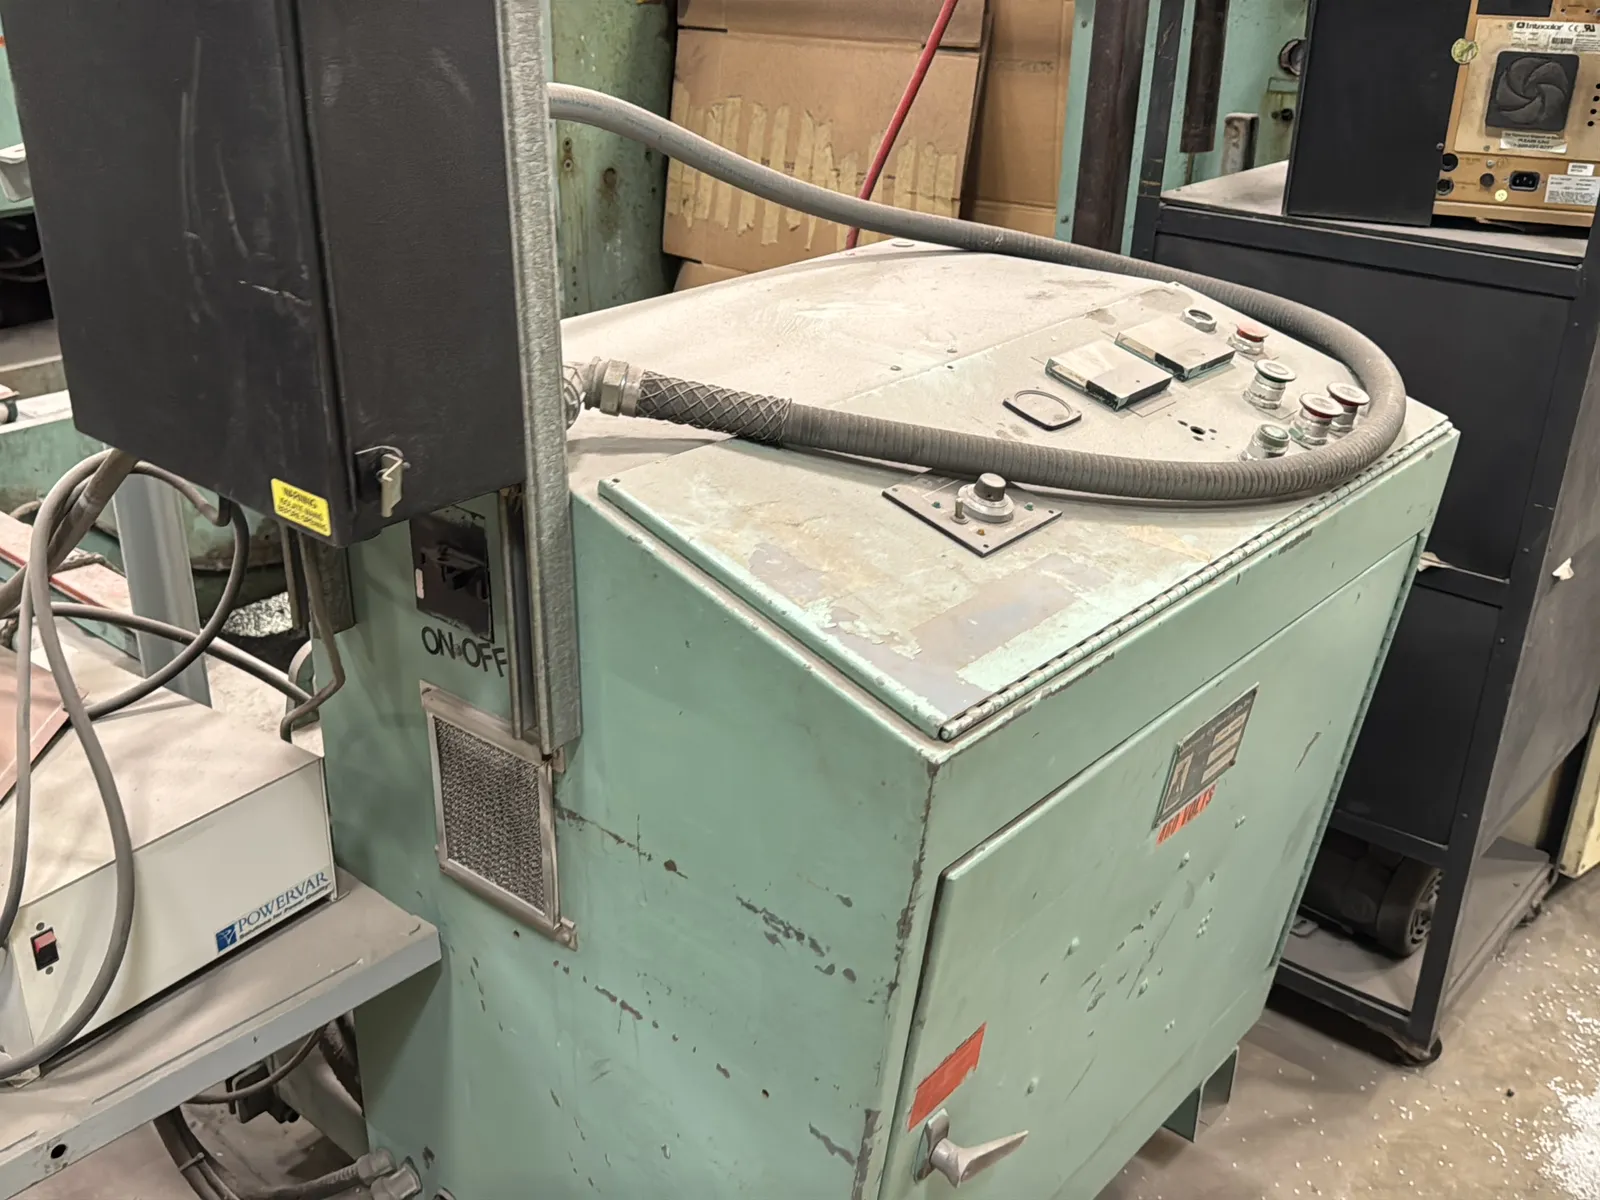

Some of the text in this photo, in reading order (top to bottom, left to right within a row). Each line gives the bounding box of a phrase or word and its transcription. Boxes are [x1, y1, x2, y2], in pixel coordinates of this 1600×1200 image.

[421, 625, 508, 678] ON OFF
[237, 871, 328, 933] POWERVAR
[272, 911, 283, 919] for
[284, 899, 304, 913] Power
